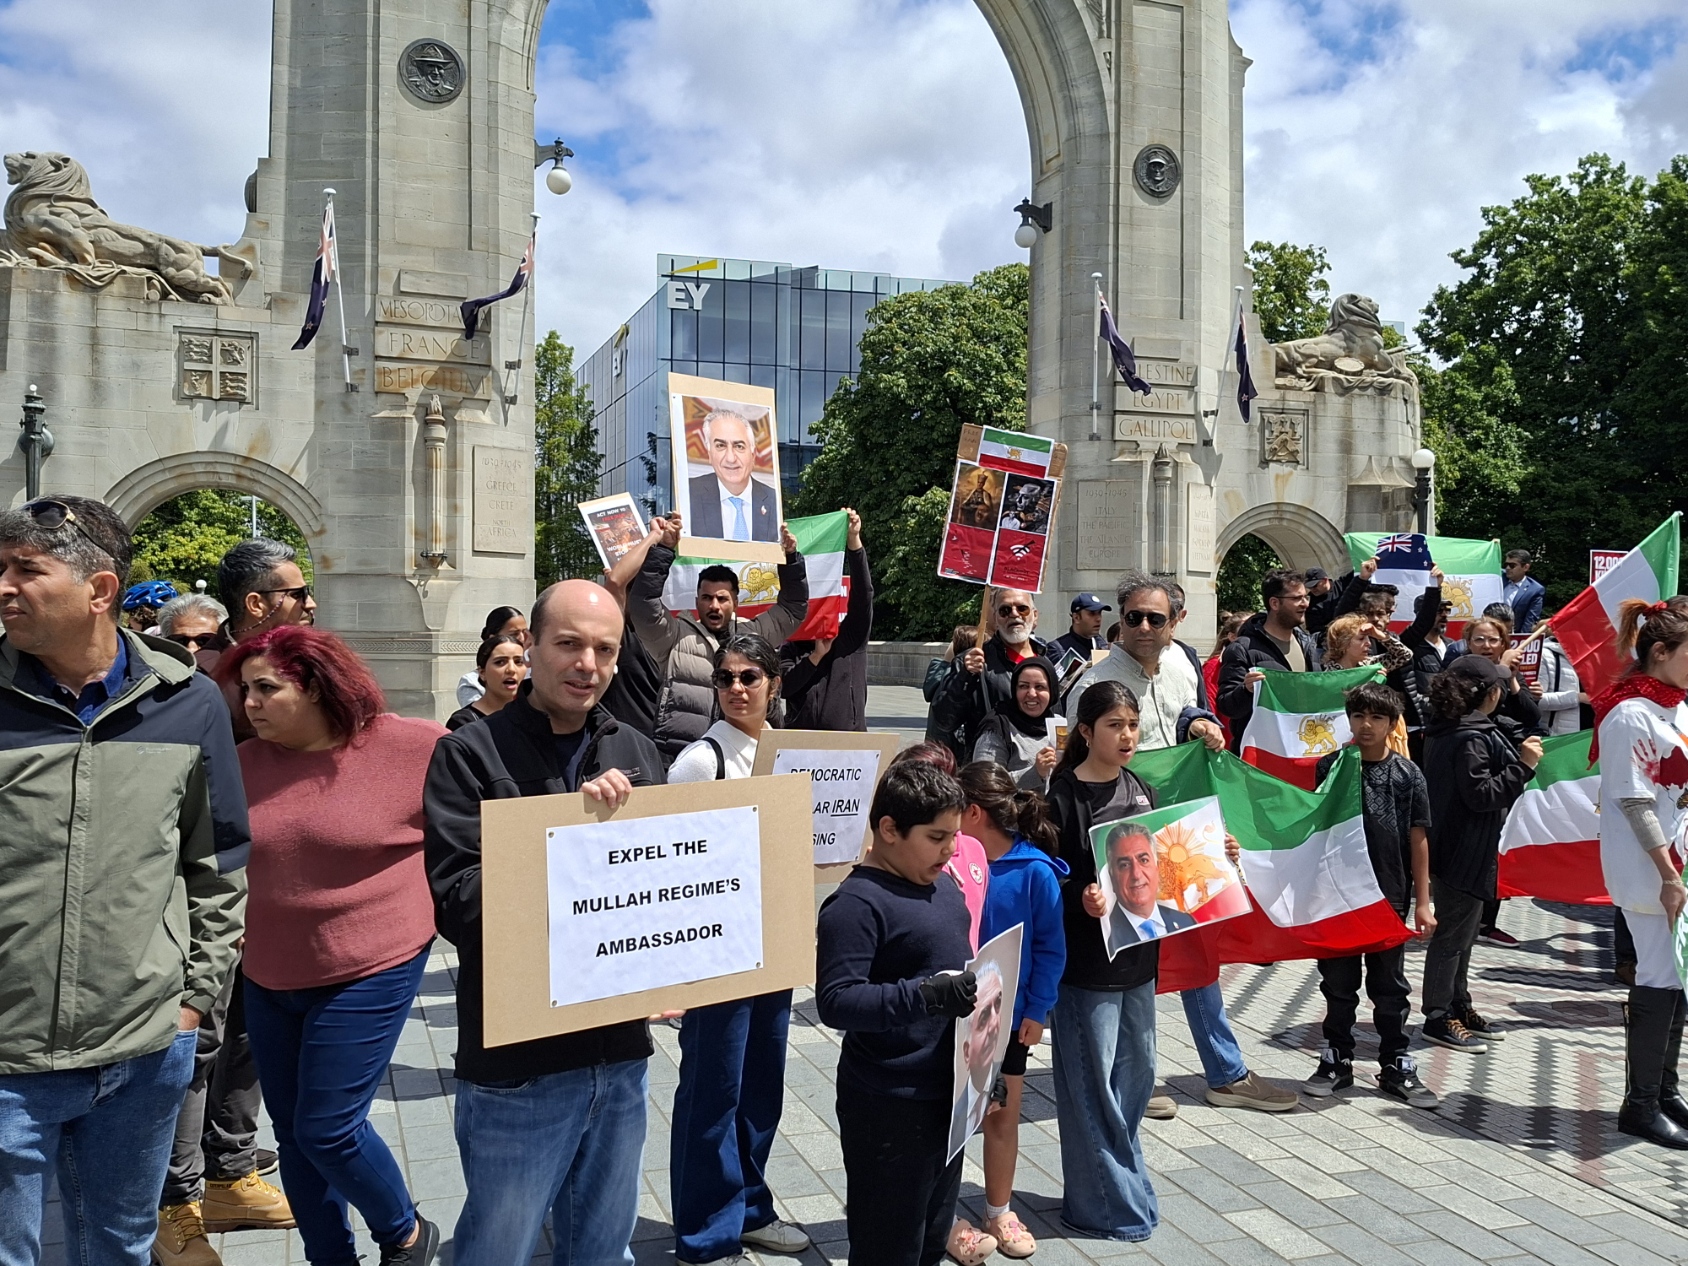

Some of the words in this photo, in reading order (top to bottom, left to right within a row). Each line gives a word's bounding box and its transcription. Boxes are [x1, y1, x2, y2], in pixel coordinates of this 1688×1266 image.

[667, 281, 711, 311] EY
[380, 299, 489, 326] MESOPOTAA
[389, 332, 480, 359] FRANCE
[382, 366, 486, 395] BELGIUM
[1138, 363, 1193, 383] LESTINE
[1133, 391, 1183, 411] EGYPT
[1119, 419, 1195, 441] GALLIPOLI
[485, 480, 518, 493] GREECE
[488, 500, 515, 511] CRETE
[1095, 506, 1118, 516] ITALY
[487, 527, 518, 538] AFRICA
[1088, 549, 1121, 559] EUROPE
[832, 799, 860, 814] IRAN
[608, 846, 667, 865] EXPEL
[672, 839, 708, 857] THE
[573, 890, 652, 916] MULLAH
[658, 878, 741, 903] REGIME’S
[595, 923, 723, 958] AMBASSADOR
